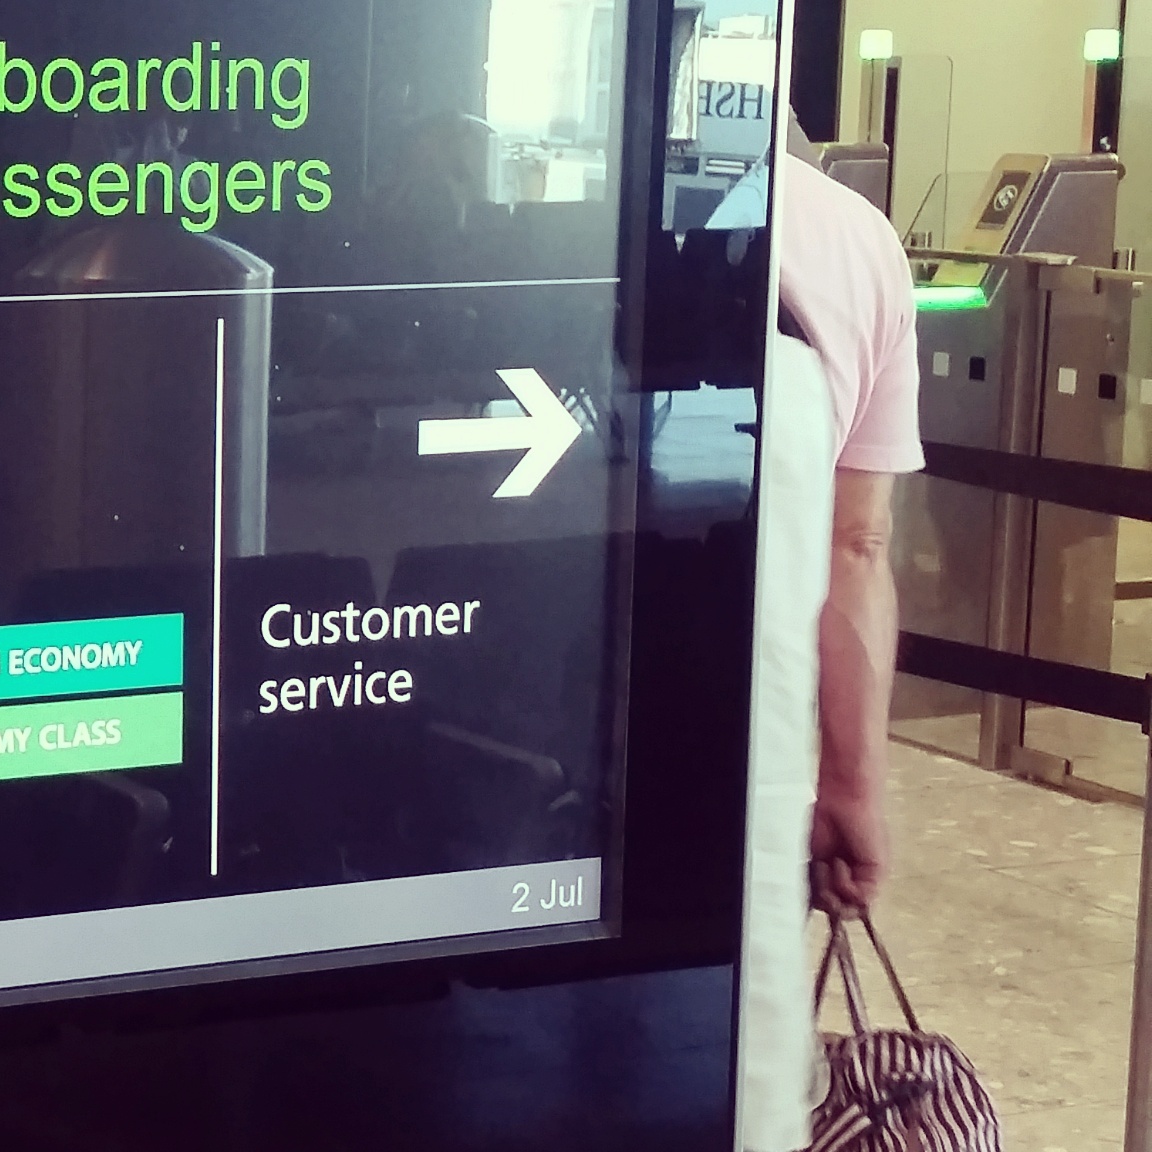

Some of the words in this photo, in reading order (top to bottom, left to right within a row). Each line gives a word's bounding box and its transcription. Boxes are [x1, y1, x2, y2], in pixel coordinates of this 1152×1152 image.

[260, 598, 481, 649] Customer
[8, 640, 143, 676] ECONOMY
[259, 661, 414, 714] service
[38, 719, 122, 751] CLASS
[511, 882, 530, 913] 2
[540, 876, 584, 910] Jul
